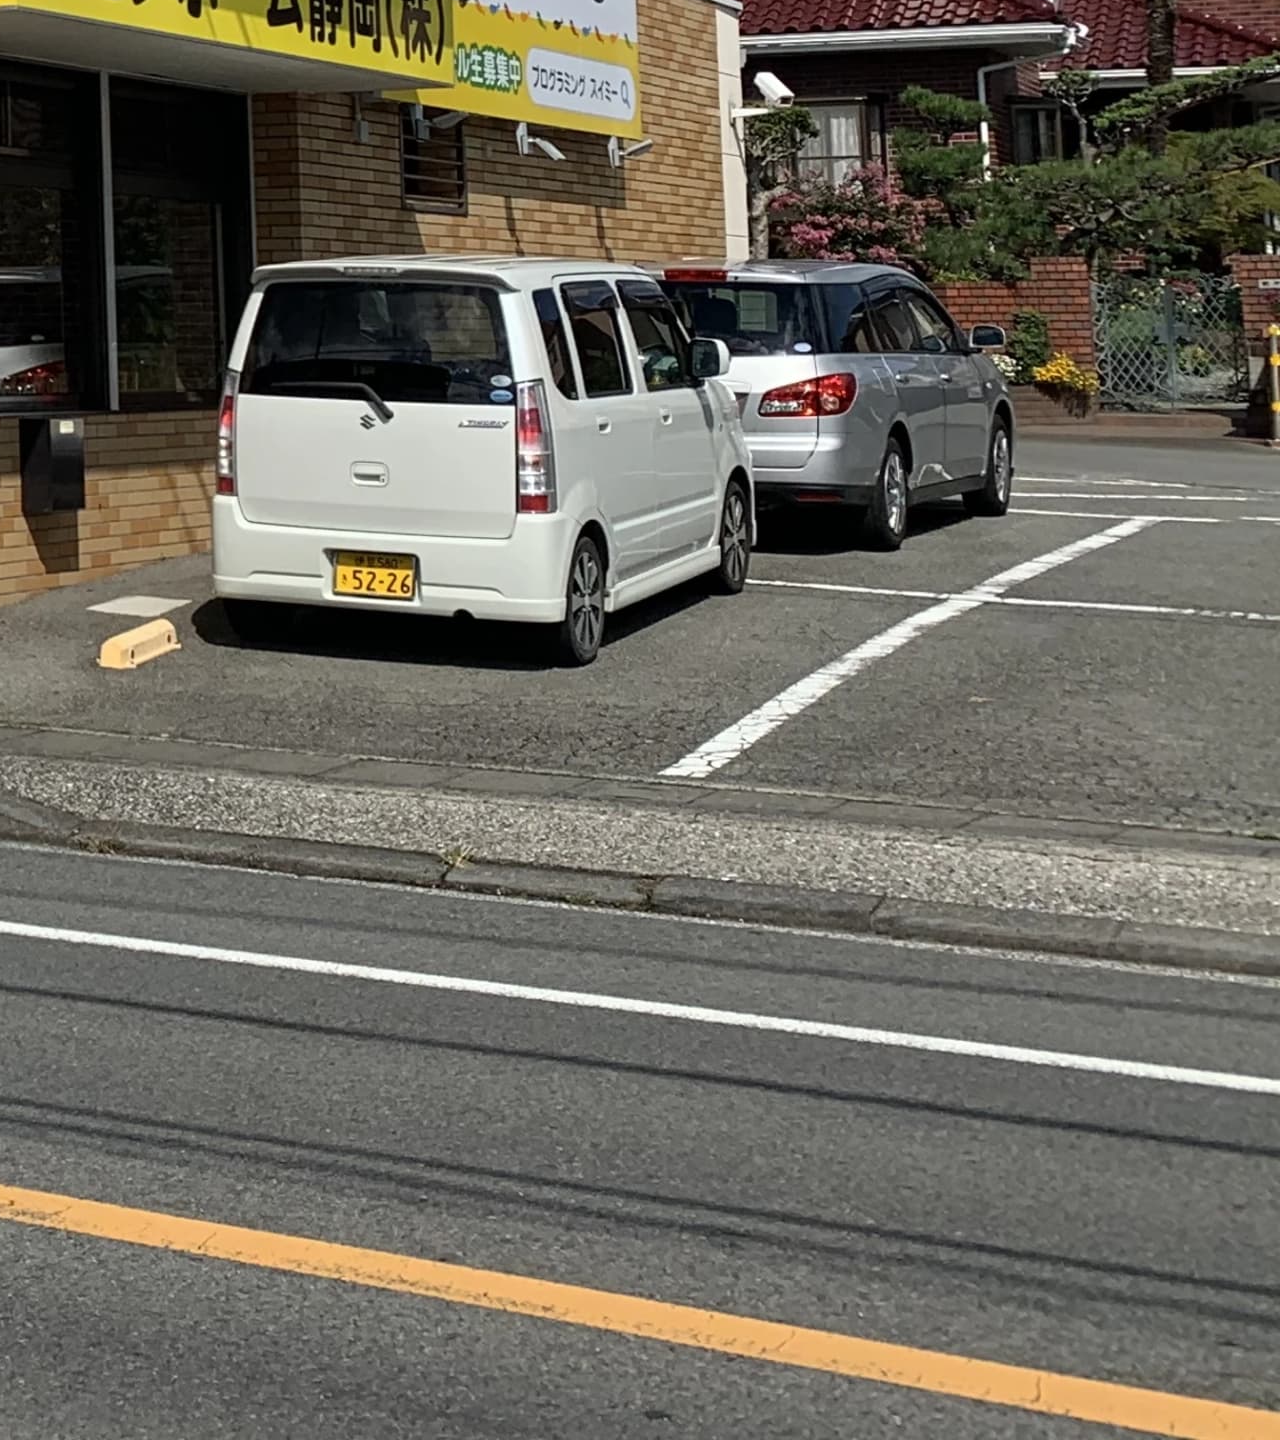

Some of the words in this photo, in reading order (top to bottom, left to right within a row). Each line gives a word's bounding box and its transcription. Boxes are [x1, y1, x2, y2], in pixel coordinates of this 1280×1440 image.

[454, 46, 522, 92] ル生募集中
[532, 65, 586, 97] プログラミング
[589, 78, 619, 102] スイミー
[352, 569, 411, 594] 52-26
